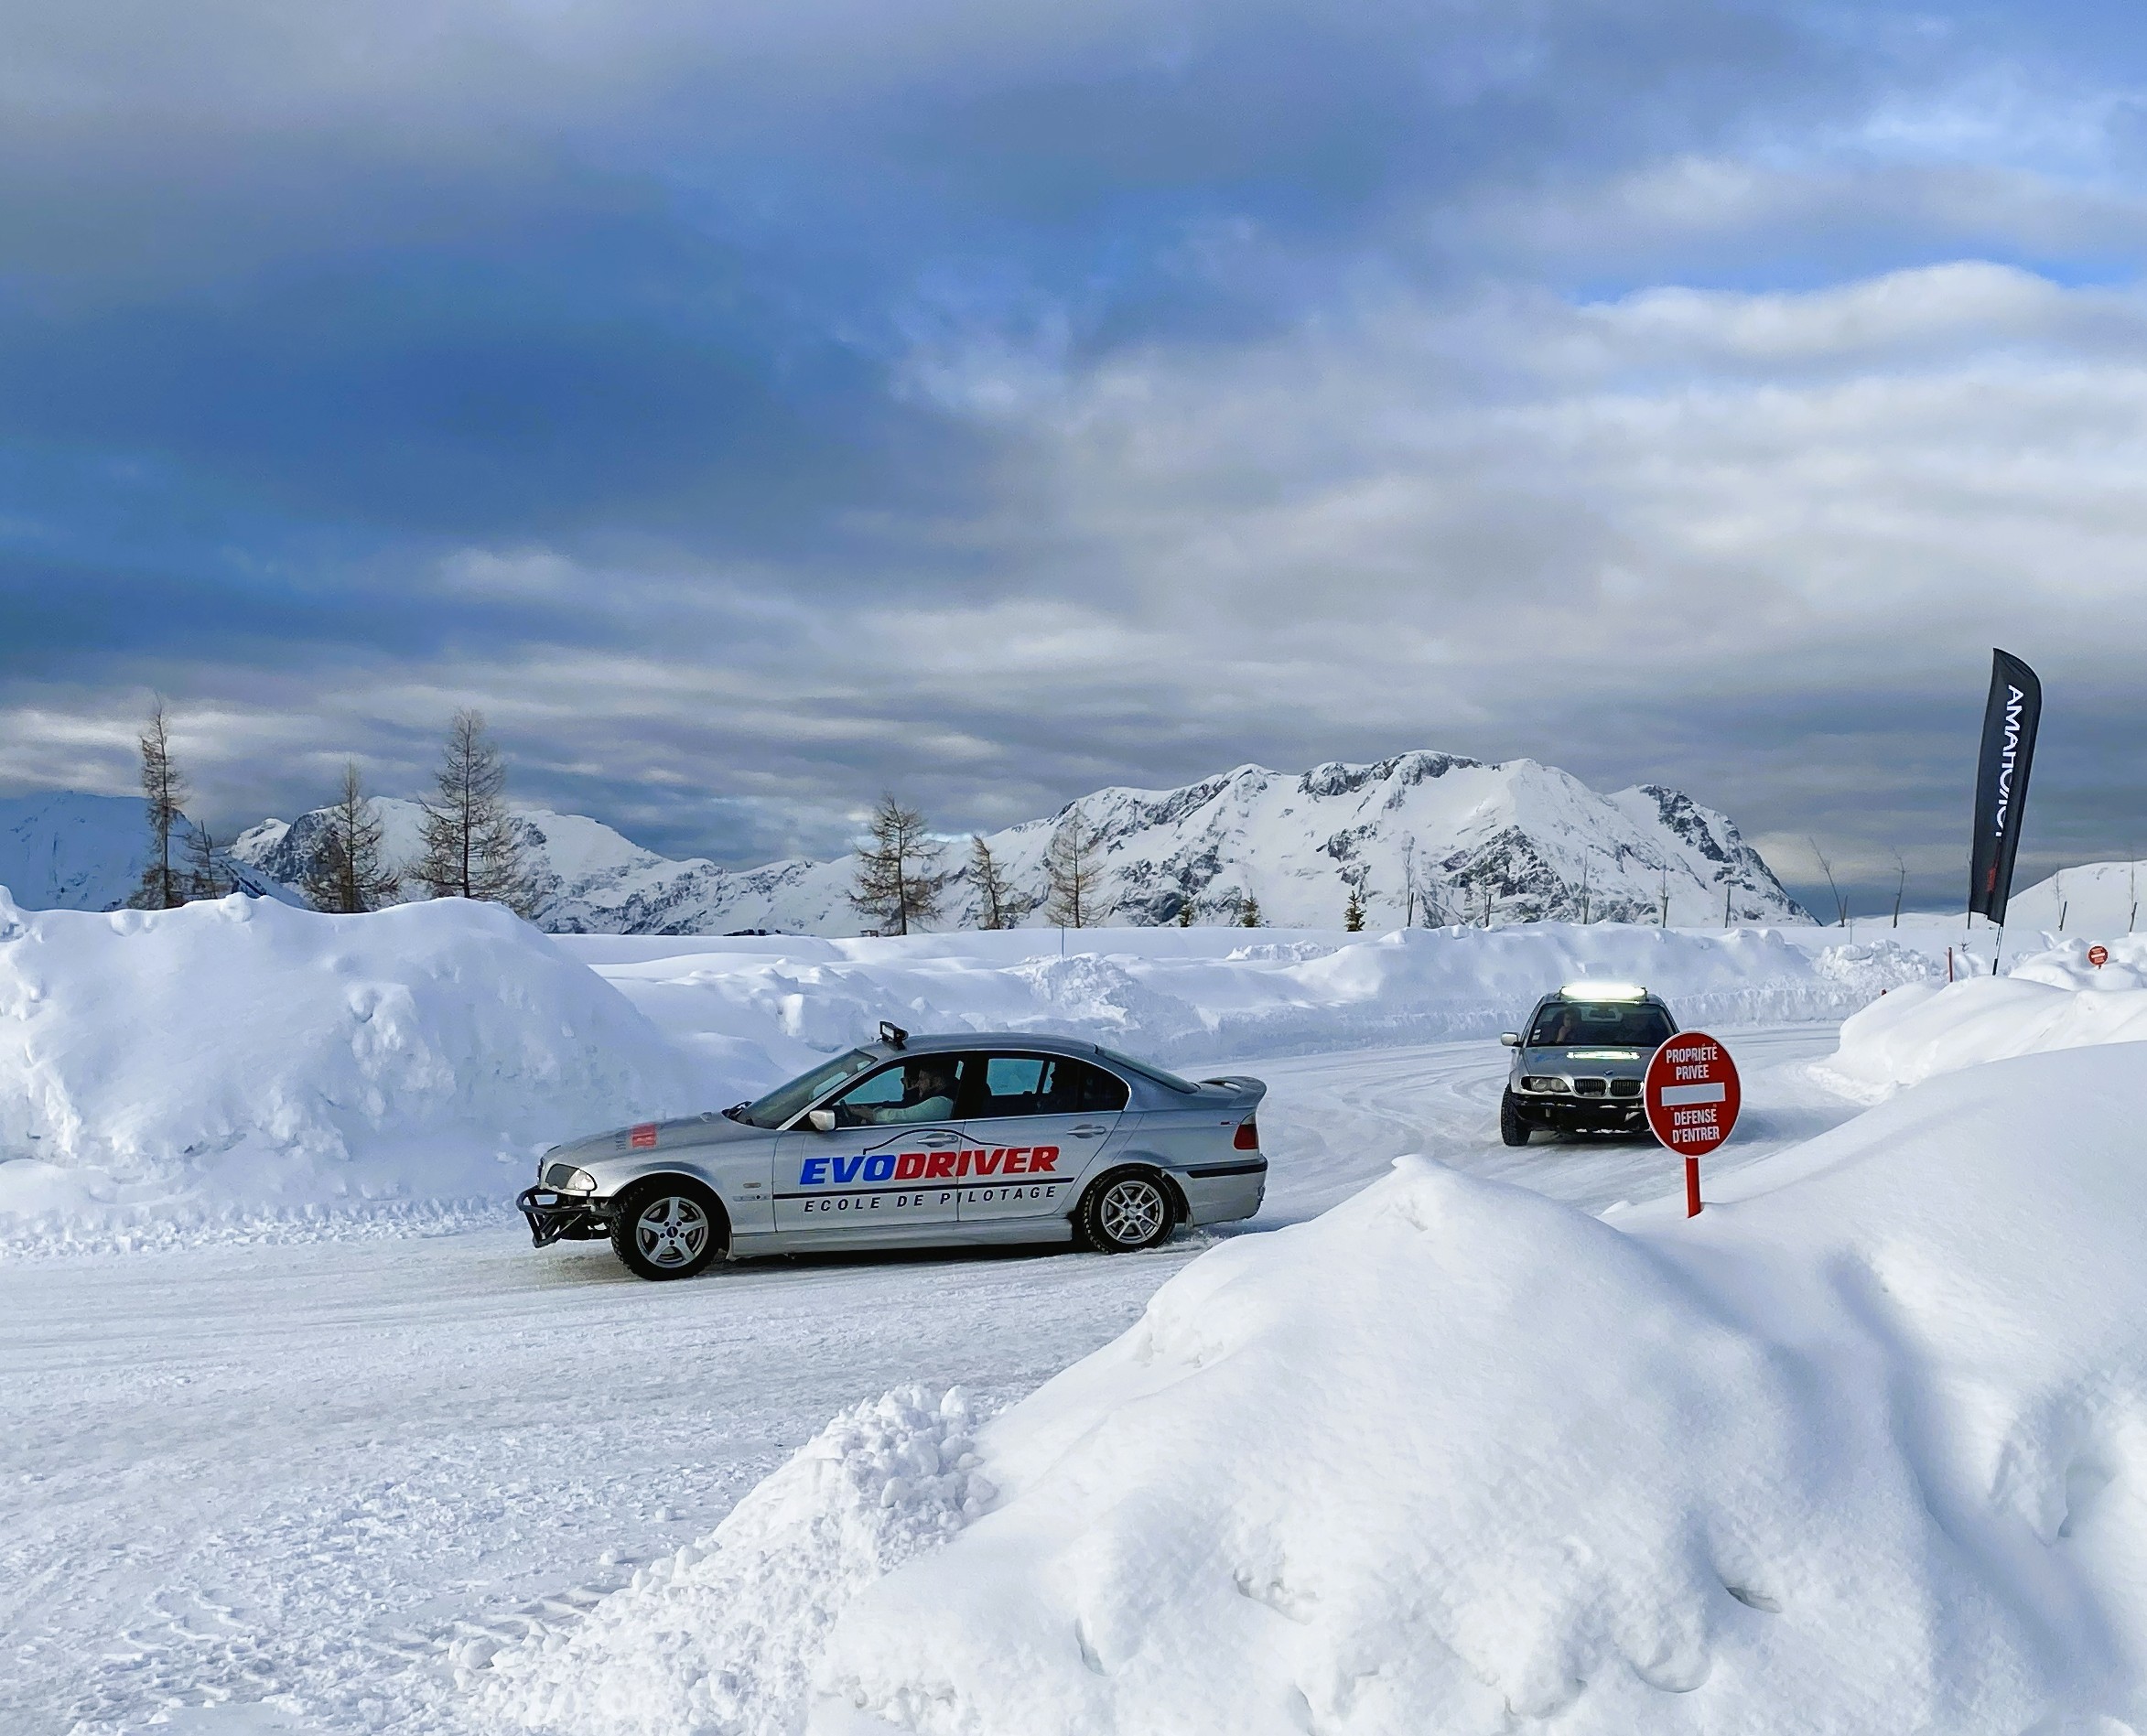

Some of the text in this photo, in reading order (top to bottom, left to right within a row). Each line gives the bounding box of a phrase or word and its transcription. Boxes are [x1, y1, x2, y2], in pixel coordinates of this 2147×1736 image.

[1666, 1042, 1718, 1063] PROPRIÉTÉ
[1676, 1062, 1710, 1080] PRIVÉE
[1674, 1107, 1717, 1127] DÉFENSE
[1672, 1126, 1721, 1144] D'ENTRER
[800, 1146, 1060, 1185] EVODRIVER
[804, 1186, 1056, 1213] ECOLE DE PILOTAGE
